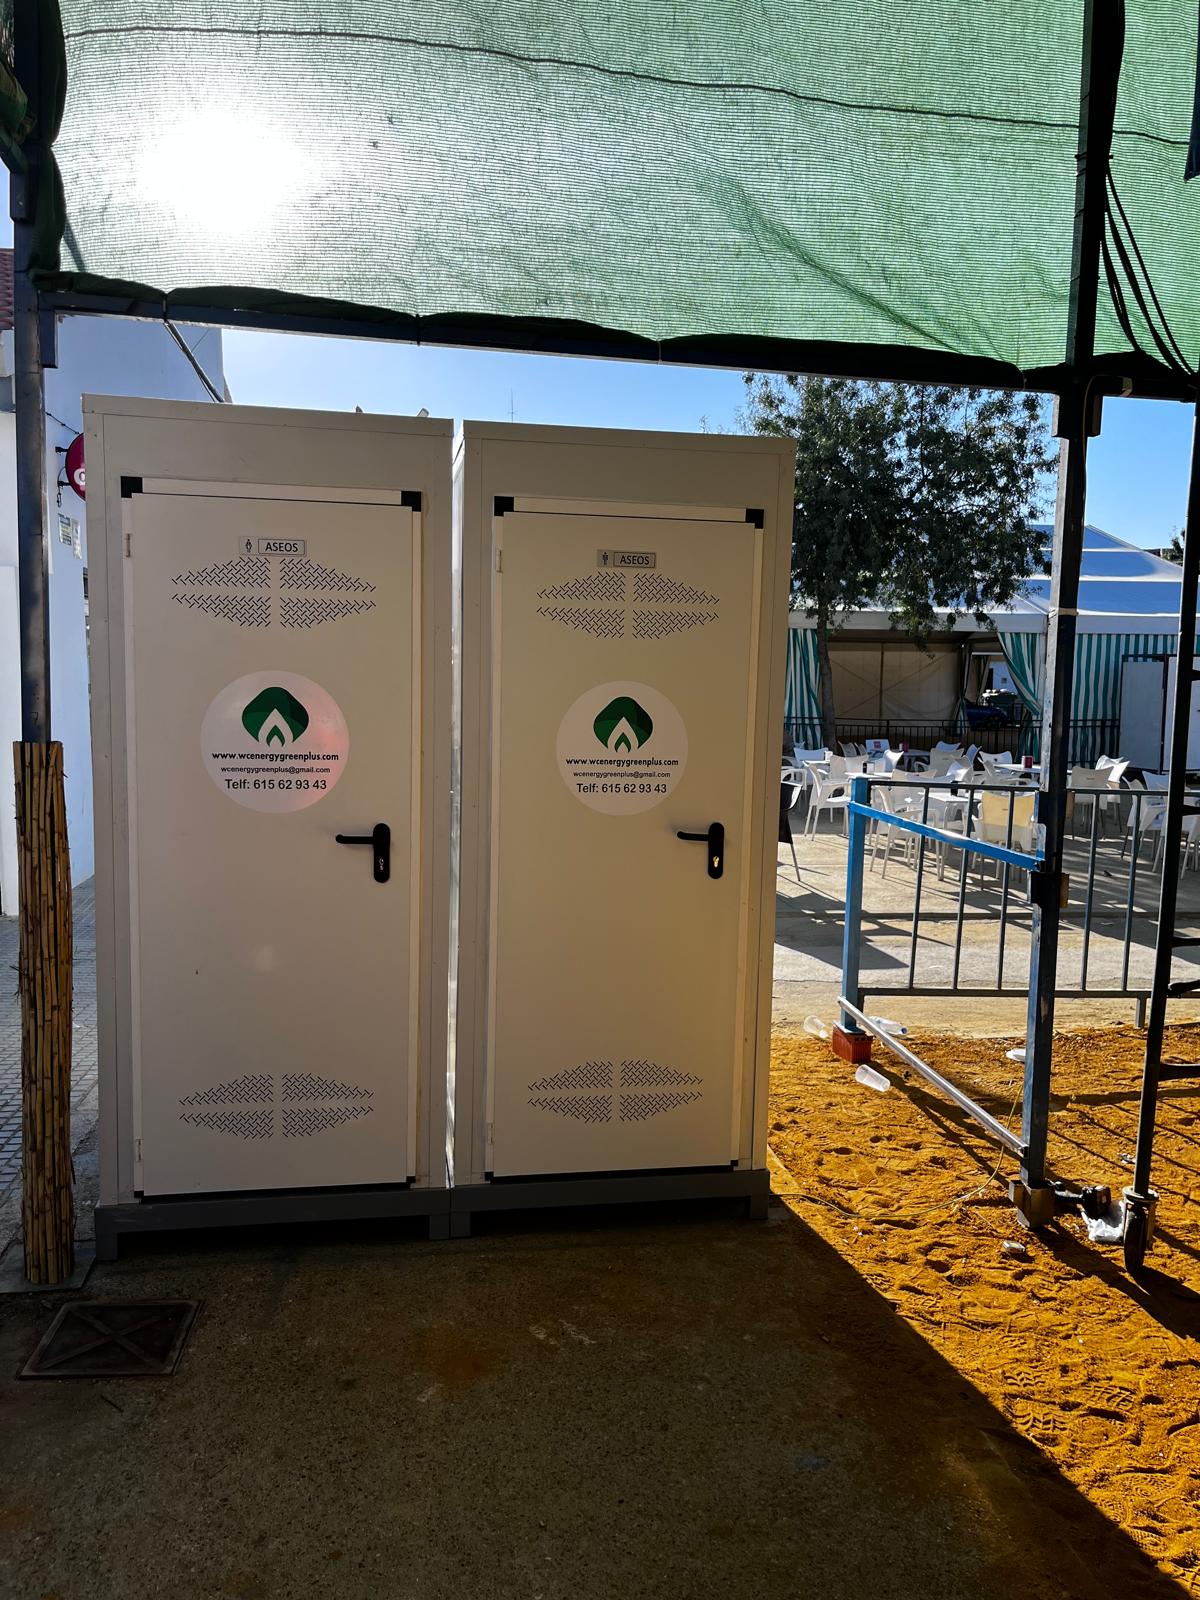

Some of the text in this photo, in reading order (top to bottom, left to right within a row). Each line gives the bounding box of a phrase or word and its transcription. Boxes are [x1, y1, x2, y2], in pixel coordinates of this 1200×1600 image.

[265, 542, 298, 552] ASEOS
[620, 554, 650, 565] ASEOS
[212, 752, 339, 762] www.wcenergygreenplus.com
[566, 756, 678, 768] www.wcenergygreenplus.com
[220, 766, 331, 774] wcenergygreenplus@gmail.com
[573, 770, 671, 779] wcenergygreenplus@gmail.com
[225, 778, 327, 790] Telf: 615 62 93 43
[576, 783, 667, 794] Telf: 615 62 93 43
